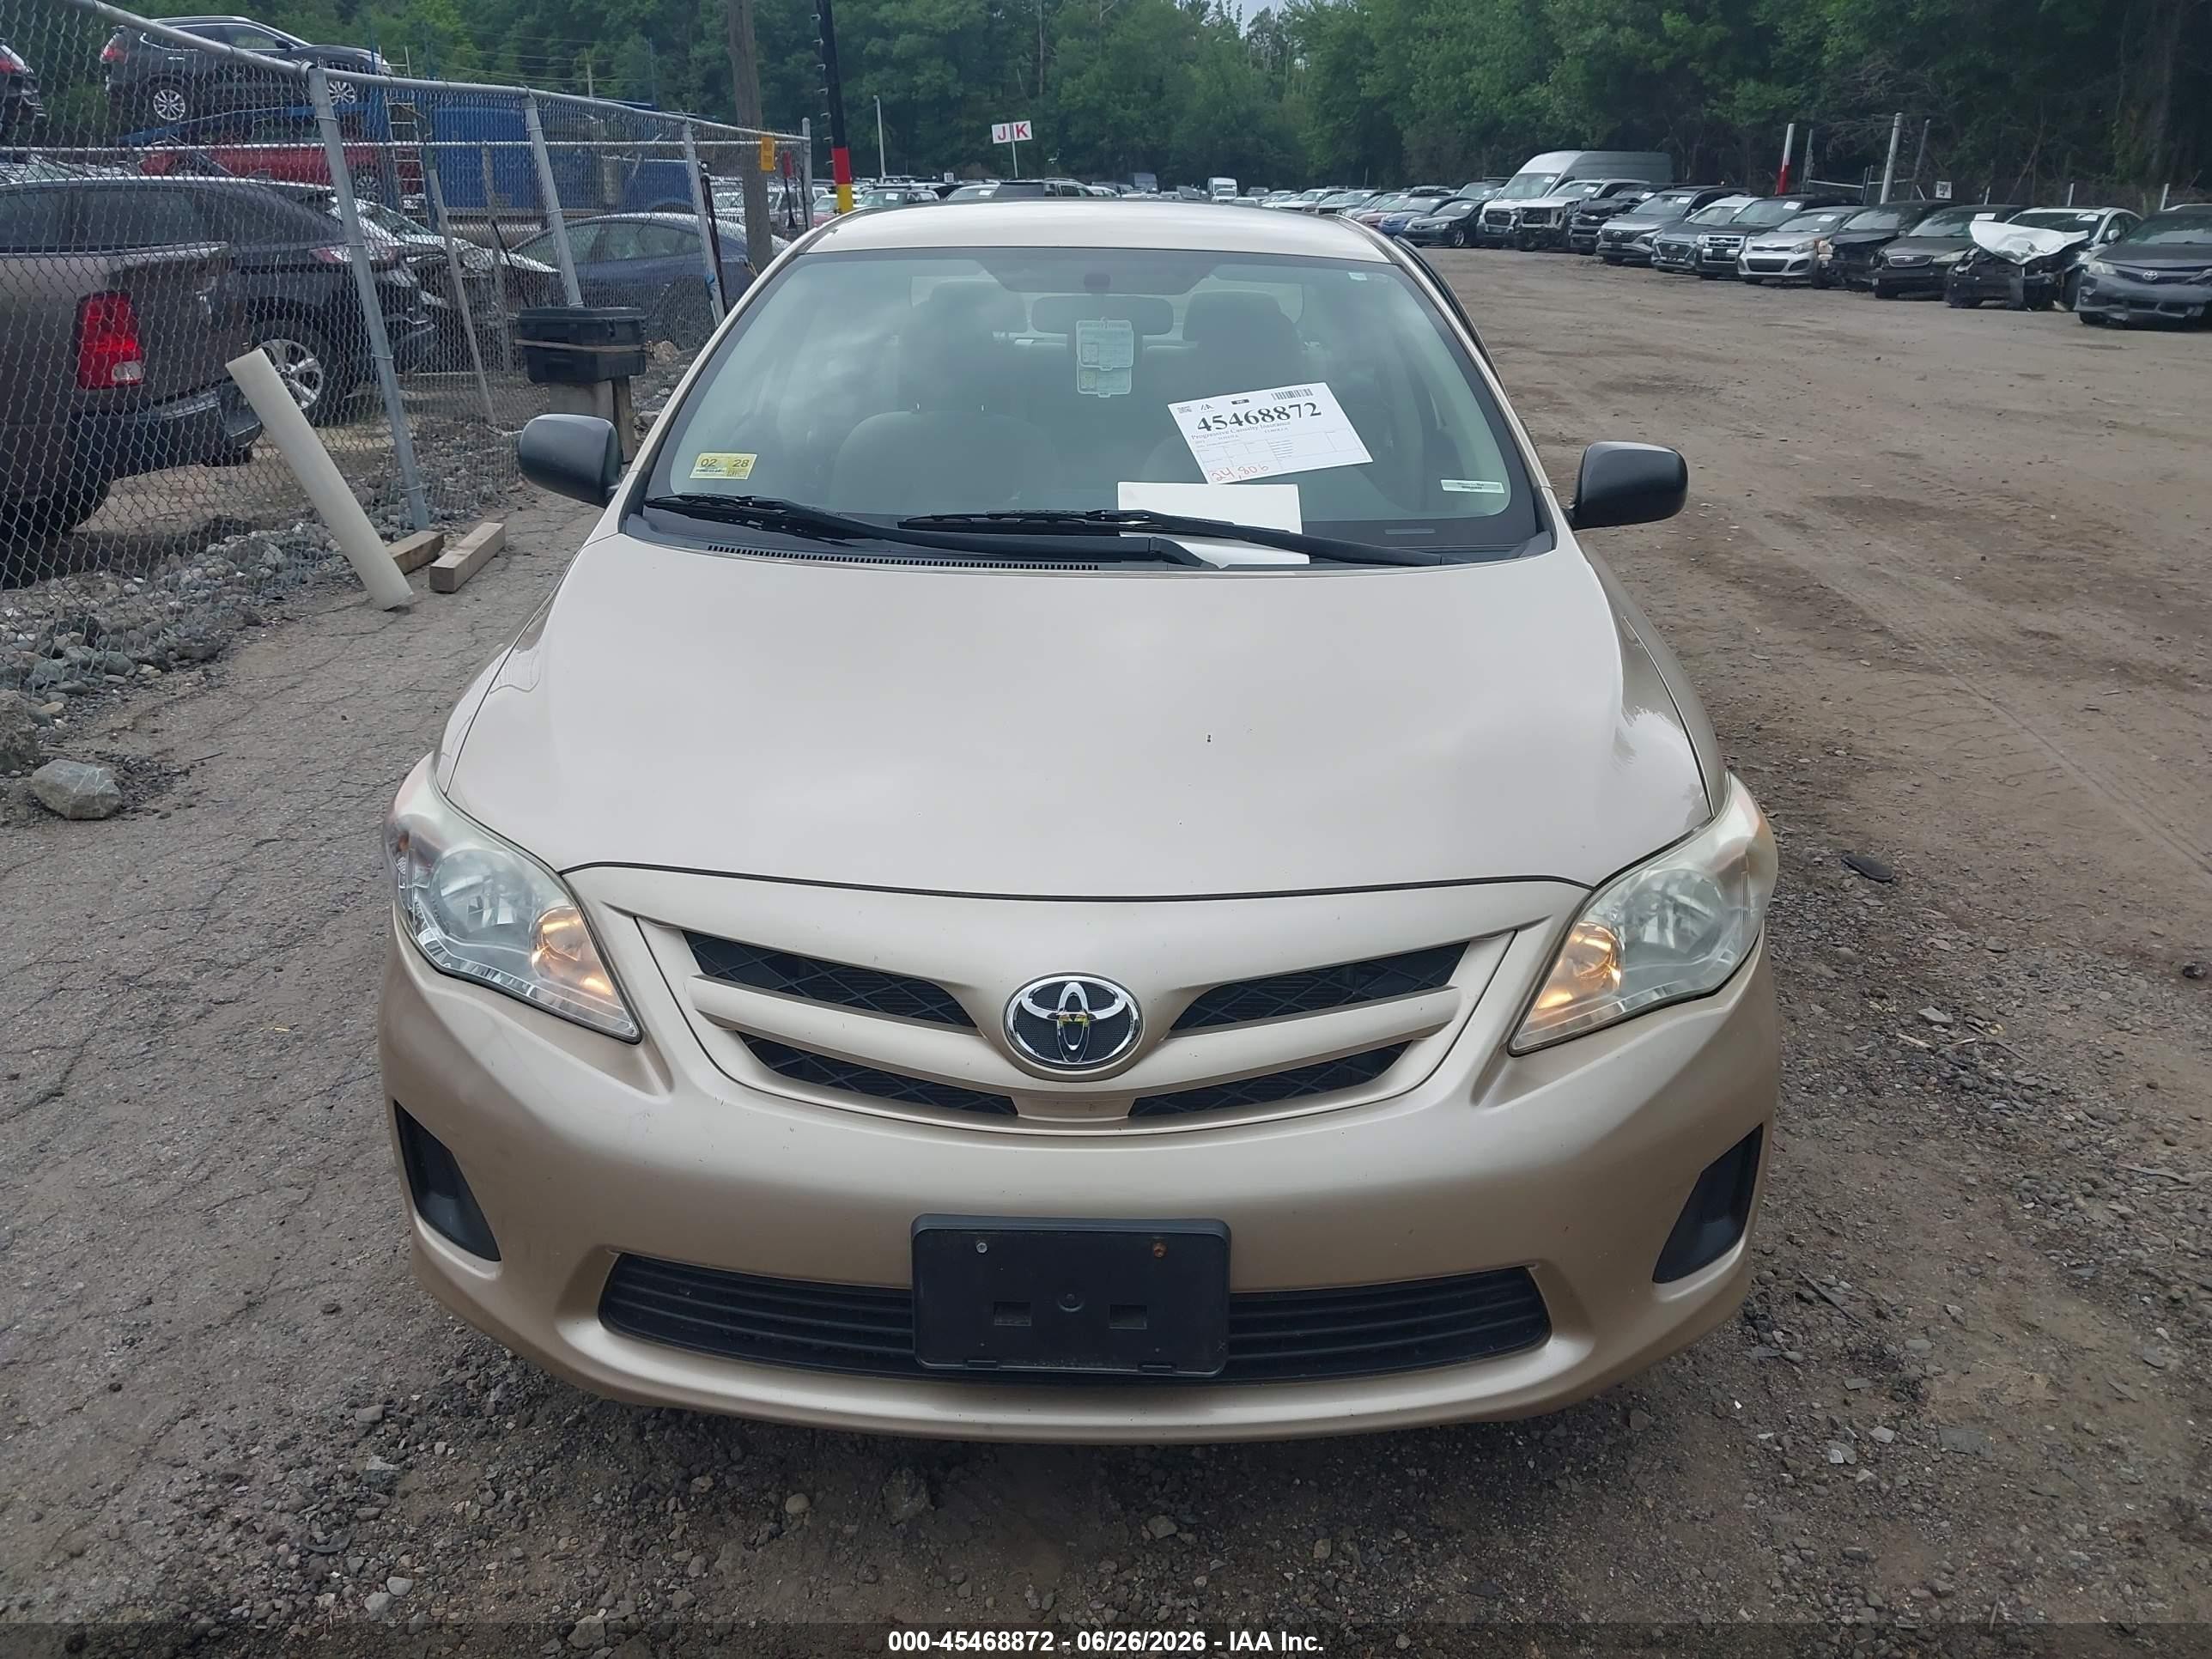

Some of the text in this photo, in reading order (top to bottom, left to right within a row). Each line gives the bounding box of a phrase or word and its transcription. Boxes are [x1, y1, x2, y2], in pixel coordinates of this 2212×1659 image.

[998, 124, 1029, 140] J K
[1197, 402, 1322, 431] 45468872
[701, 459, 750, 468] 02 28
